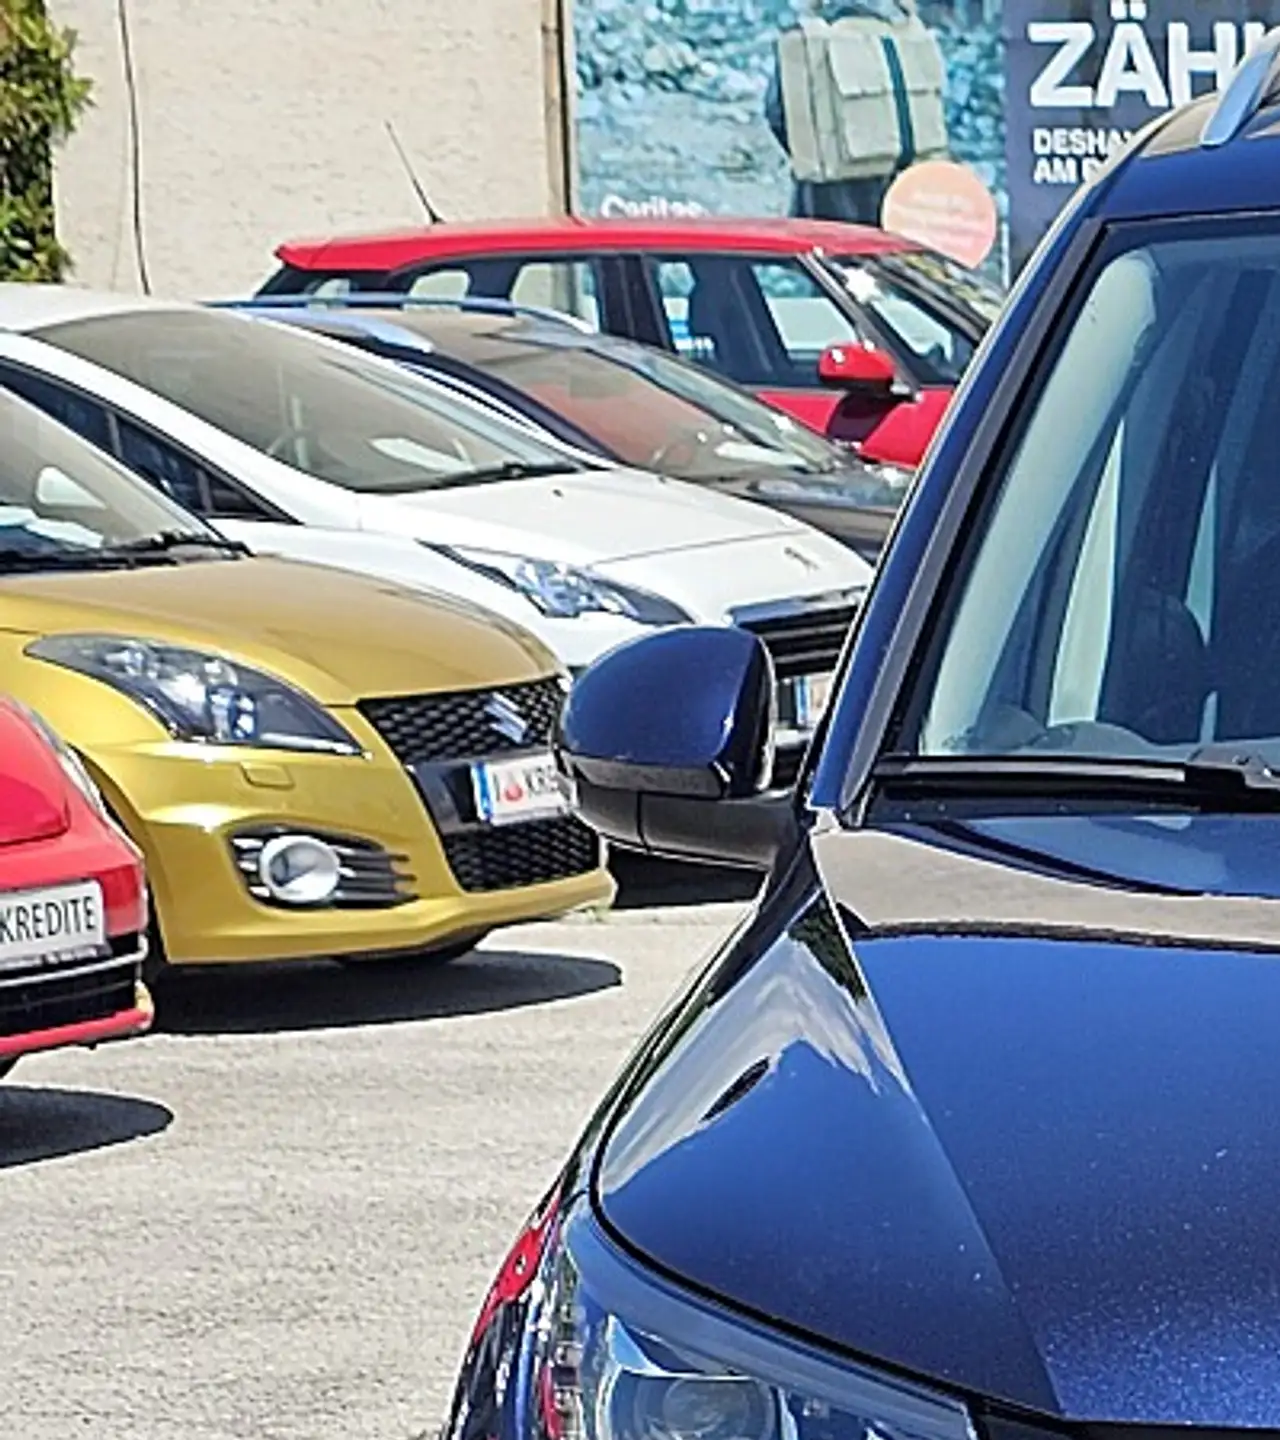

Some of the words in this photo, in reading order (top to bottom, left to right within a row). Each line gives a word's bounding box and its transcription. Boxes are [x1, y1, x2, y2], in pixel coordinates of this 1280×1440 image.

[1027, 0, 1265, 107] ZÄH
[1033, 127, 1133, 155] DESHA
[1033, 157, 1078, 184] AM
[0, 896, 96, 942] KREDITE
